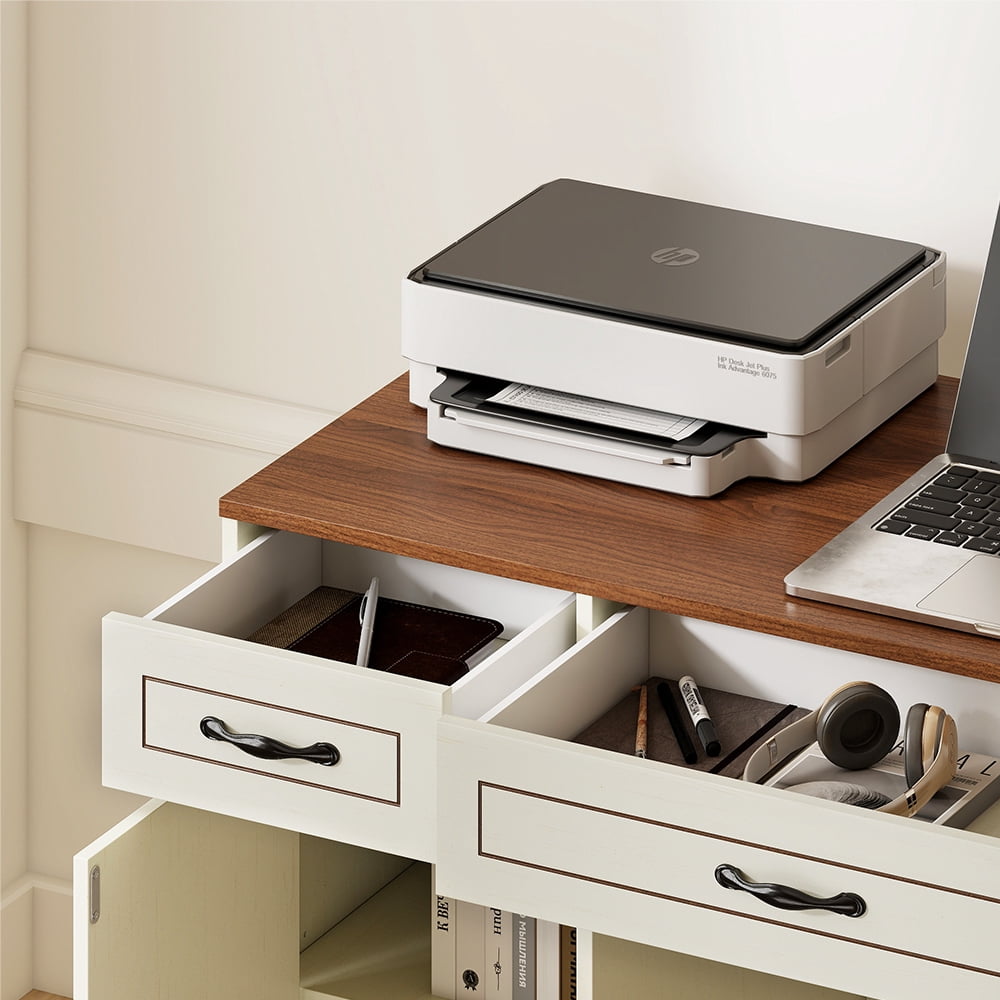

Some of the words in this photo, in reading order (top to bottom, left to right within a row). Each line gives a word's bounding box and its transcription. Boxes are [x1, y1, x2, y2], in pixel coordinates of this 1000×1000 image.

[717, 355, 728, 363] HP
[728, 357, 745, 367] Desk
[745, 361, 756, 369] Jet
[756, 363, 771, 372] Plus
[717, 362, 728, 370] Ink
[728, 364, 761, 377] Advantage
[761, 370, 777, 380] 6075
[518, 921, 527, 989] МЫШЛЕНИЯ
